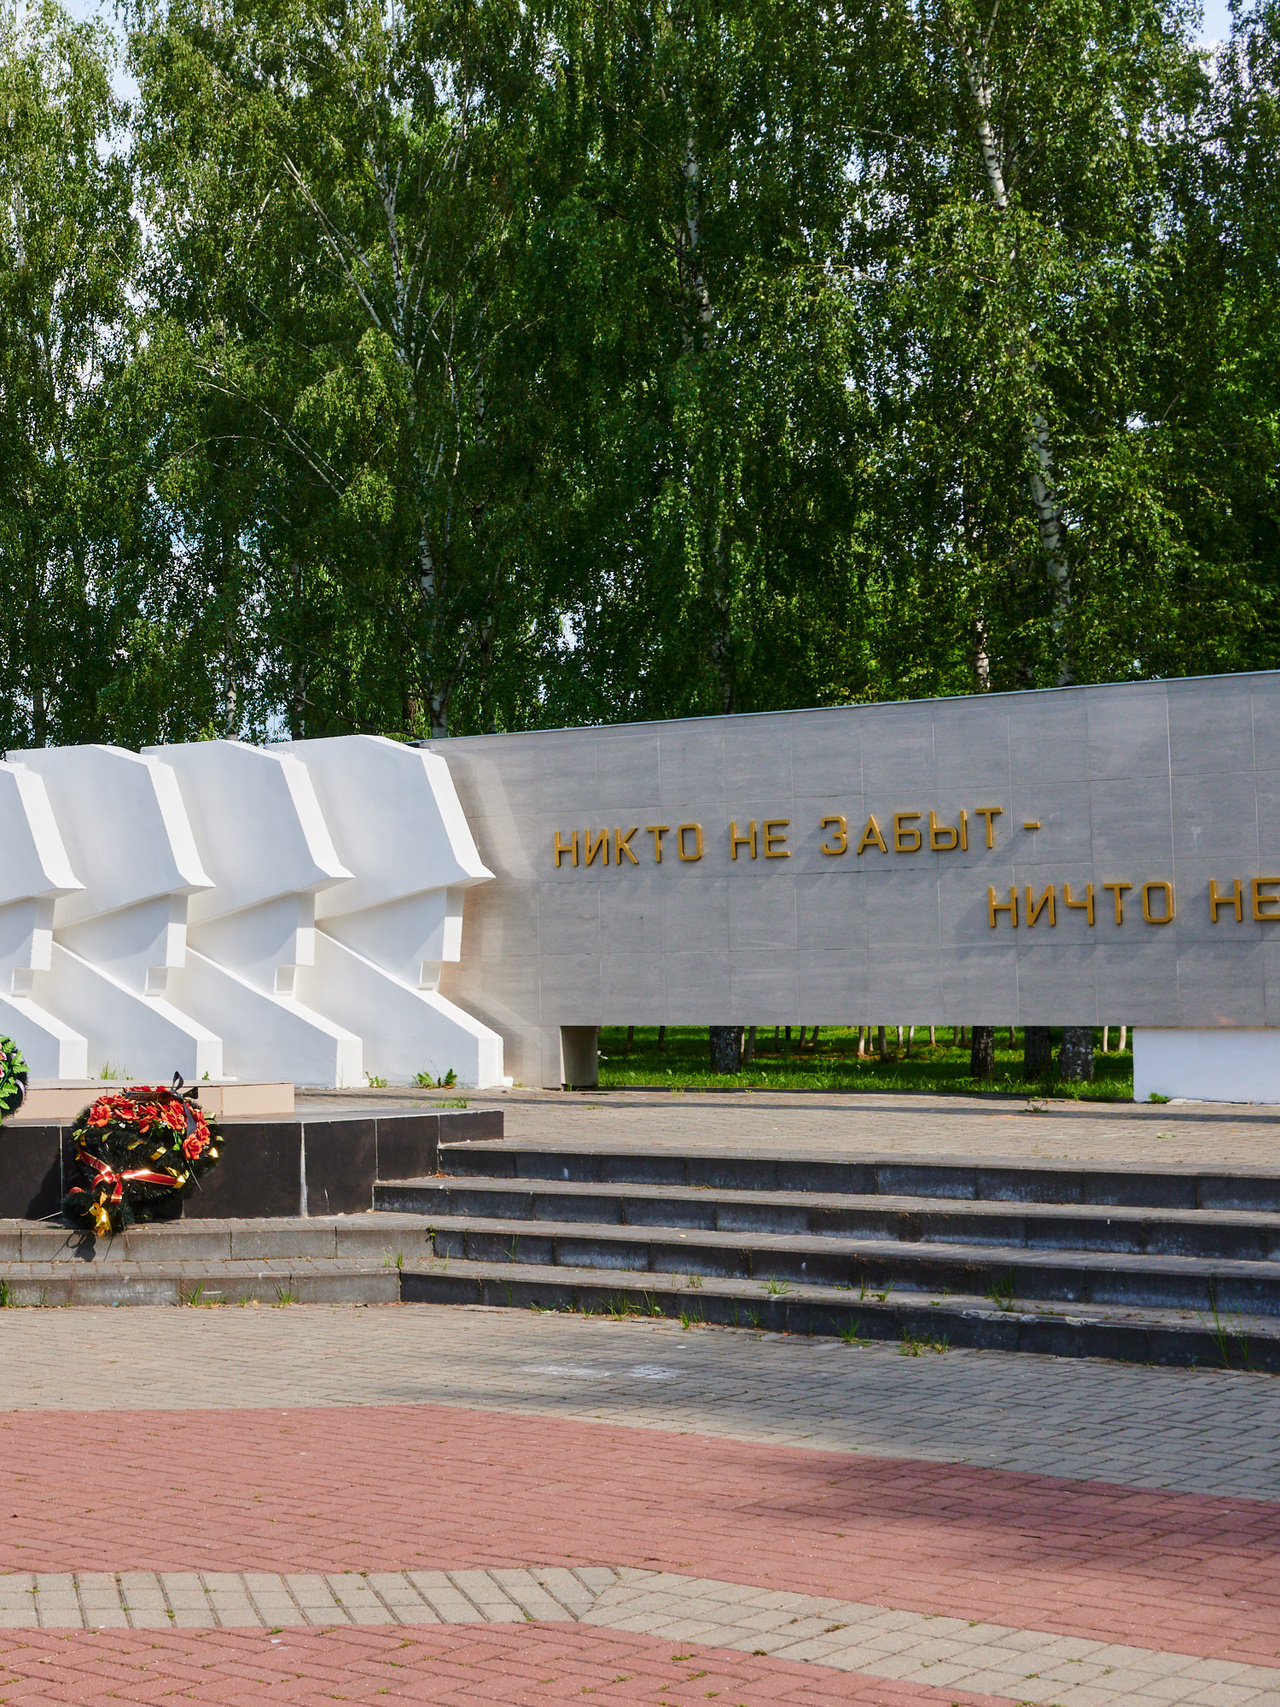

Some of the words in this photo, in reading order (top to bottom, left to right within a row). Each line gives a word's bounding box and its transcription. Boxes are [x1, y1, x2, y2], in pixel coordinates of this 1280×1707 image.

[554, 823, 704, 868] НИКТО
[730, 819, 791, 860] НЕ
[821, 807, 1003, 855] ЗАБЫТ
[988, 881, 1175, 928] НИЧТО
[1209, 877, 1280, 923] НЕ
